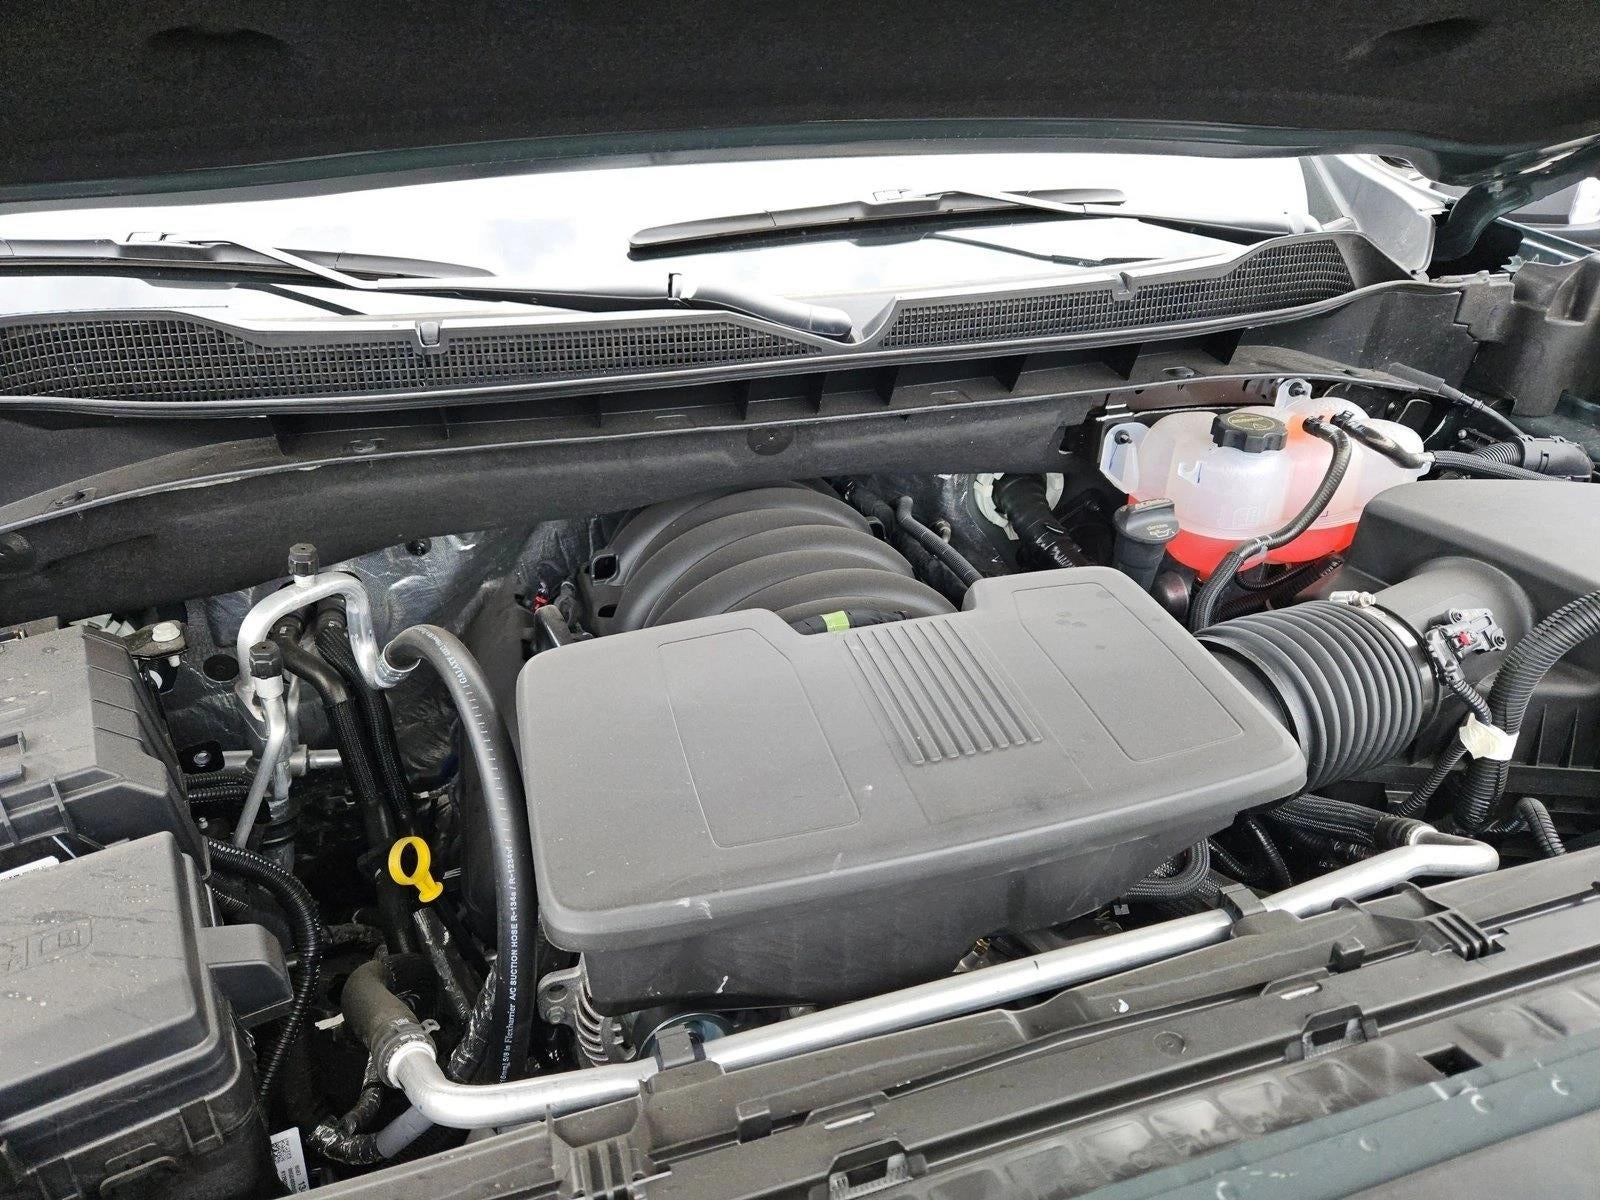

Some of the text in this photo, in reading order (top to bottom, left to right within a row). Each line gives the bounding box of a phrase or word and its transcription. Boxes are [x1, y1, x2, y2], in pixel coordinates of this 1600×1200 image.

[447, 656, 467, 683] GALAXY
[510, 892, 518, 921] R-134a
[510, 949, 518, 985] SUCTION
[509, 987, 517, 1001] A/C
